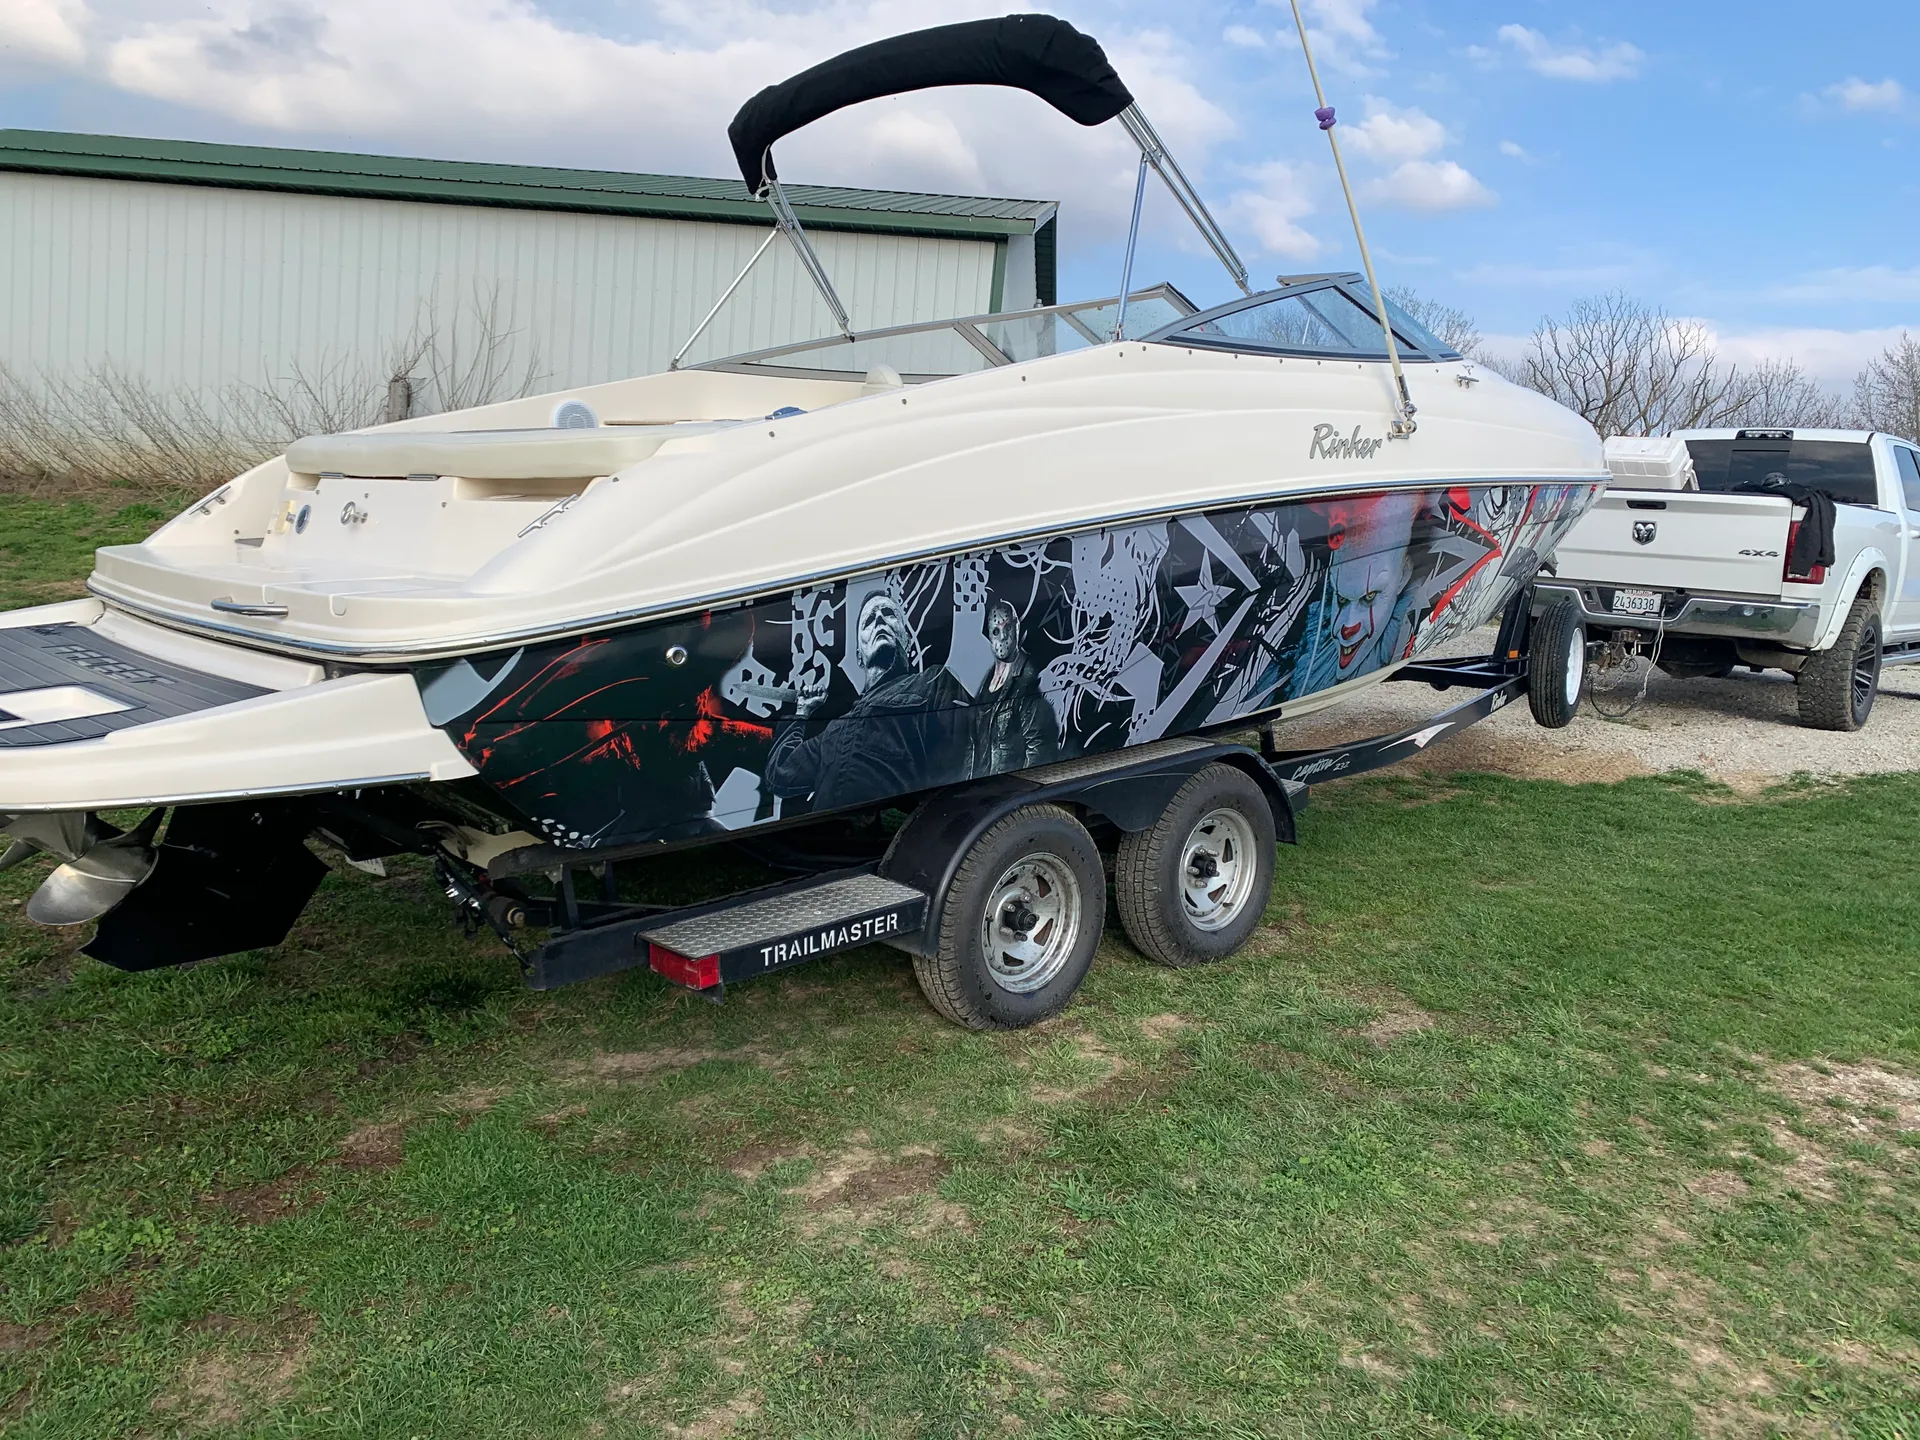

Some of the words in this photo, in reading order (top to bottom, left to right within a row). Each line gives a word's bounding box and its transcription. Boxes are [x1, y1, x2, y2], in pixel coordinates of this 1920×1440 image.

[1309, 423, 1383, 459] Rinker
[1613, 595, 1655, 611] 2436338
[760, 913, 898, 966] TRAILMASTER
